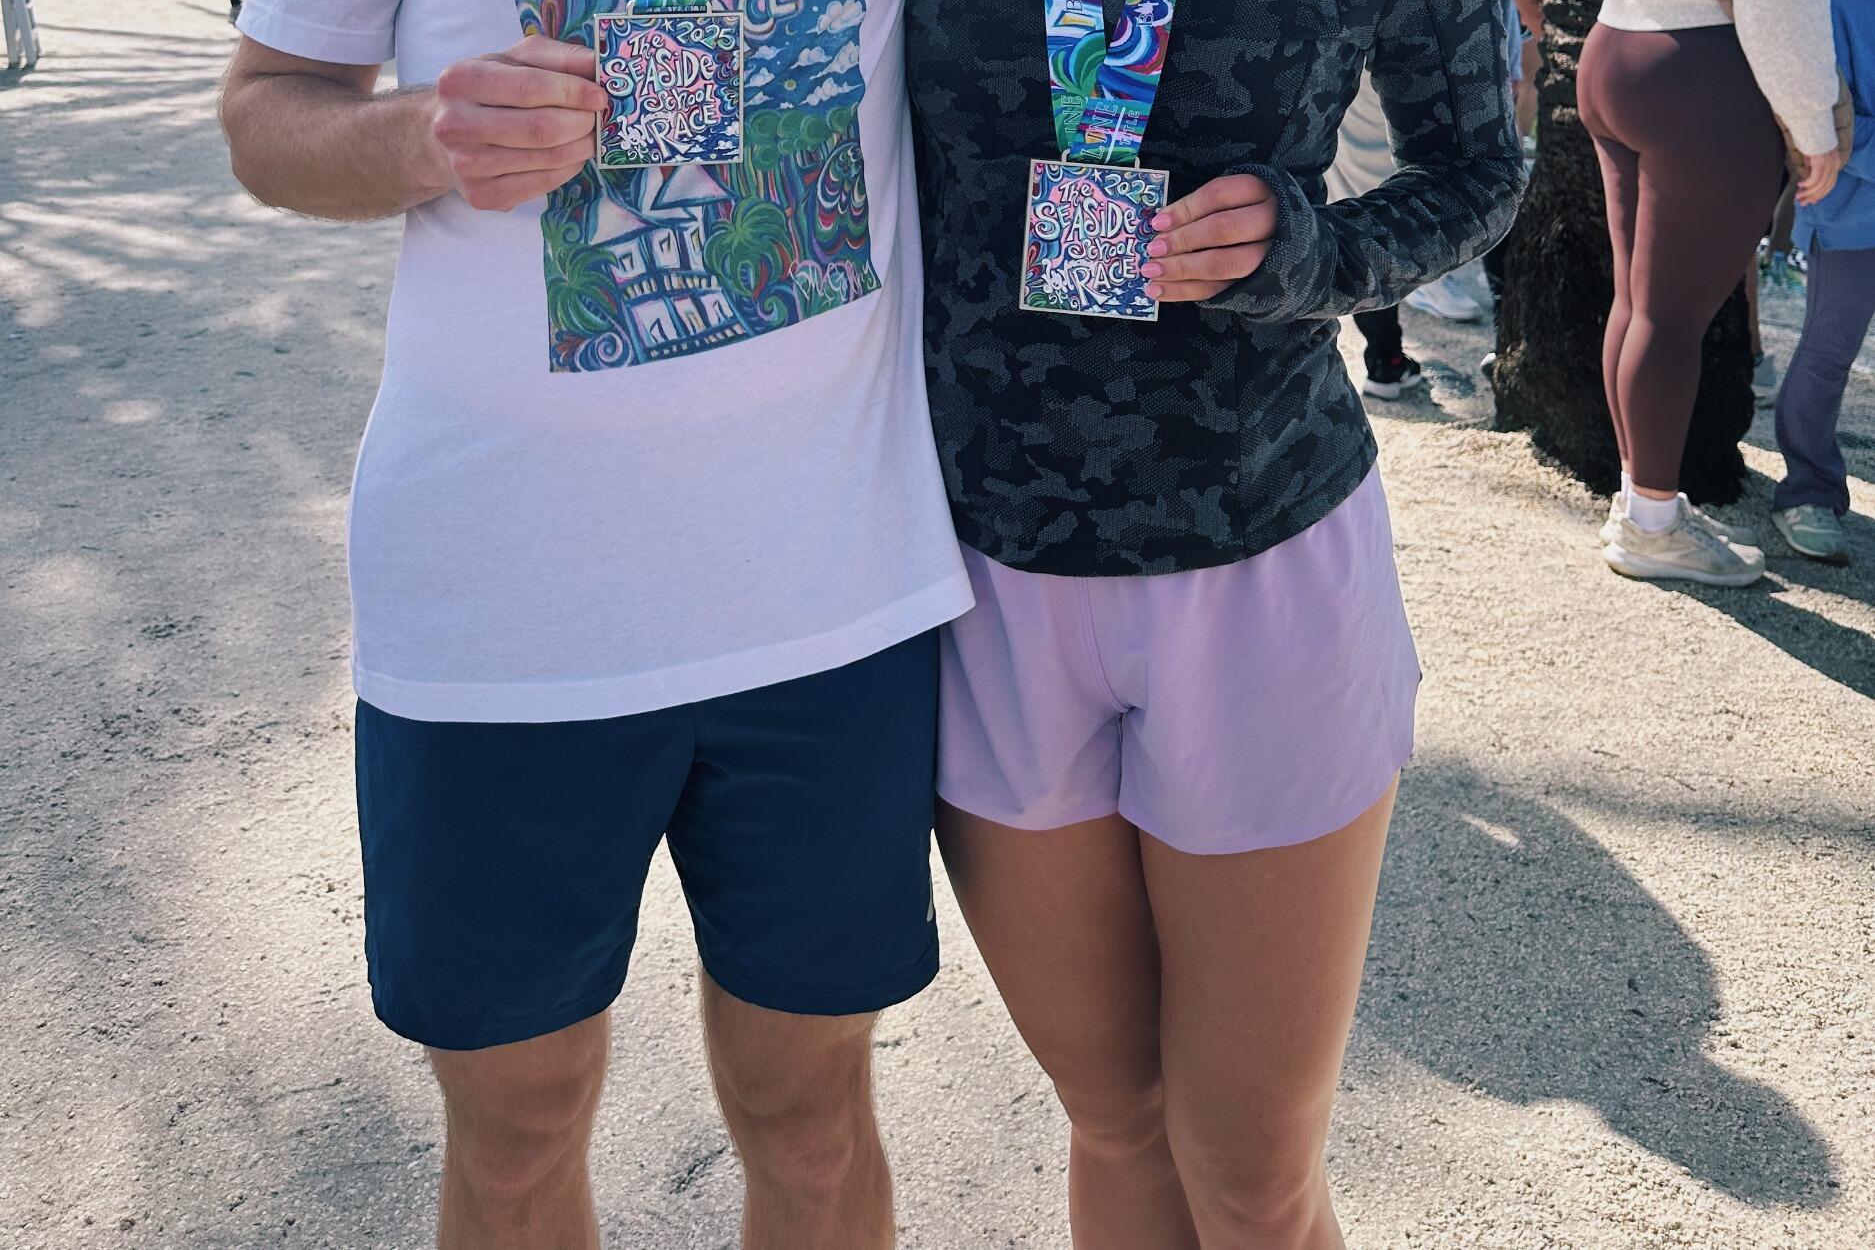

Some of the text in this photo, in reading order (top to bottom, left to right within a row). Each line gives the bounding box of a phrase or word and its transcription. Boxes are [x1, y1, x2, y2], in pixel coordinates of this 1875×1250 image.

[628, 32, 665, 60] The
[675, 21, 736, 51] 2025
[648, 104, 719, 158] RACE
[1119, 109, 1140, 146] TITLE
[1057, 181, 1094, 208] The
[1104, 173, 1160, 207] 2025
[1072, 258, 1137, 306] RACE
